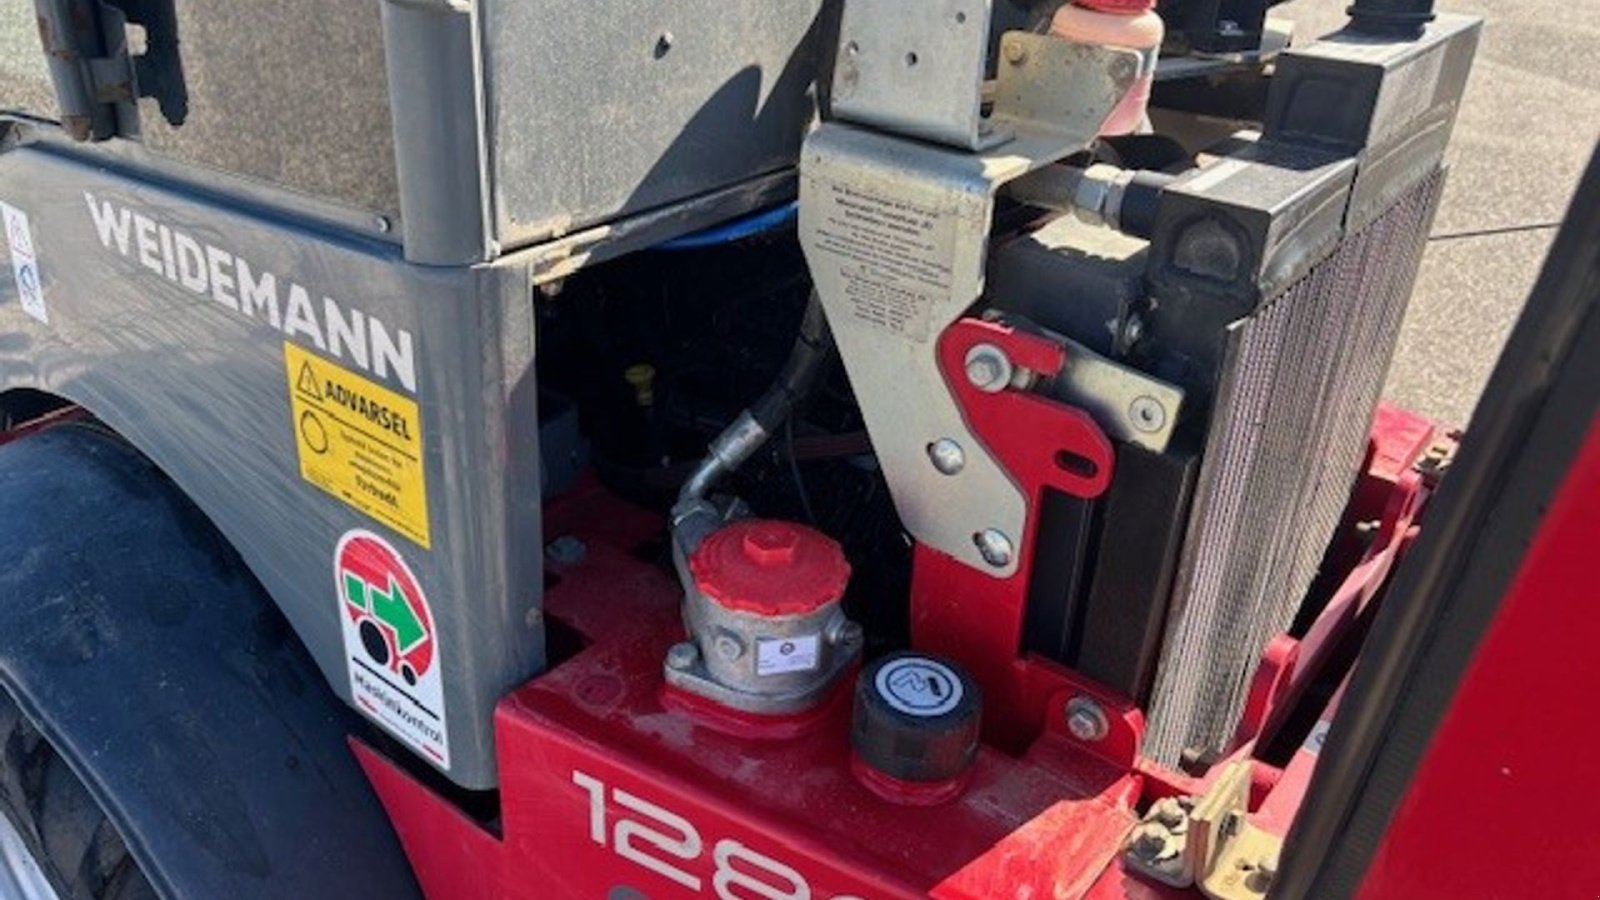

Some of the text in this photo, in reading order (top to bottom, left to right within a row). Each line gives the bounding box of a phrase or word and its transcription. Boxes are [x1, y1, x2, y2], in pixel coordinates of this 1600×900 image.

[84, 190, 416, 394] WEIDEMANN
[324, 379, 412, 441] ADVARSEL
[572, 769, 862, 900] 128
